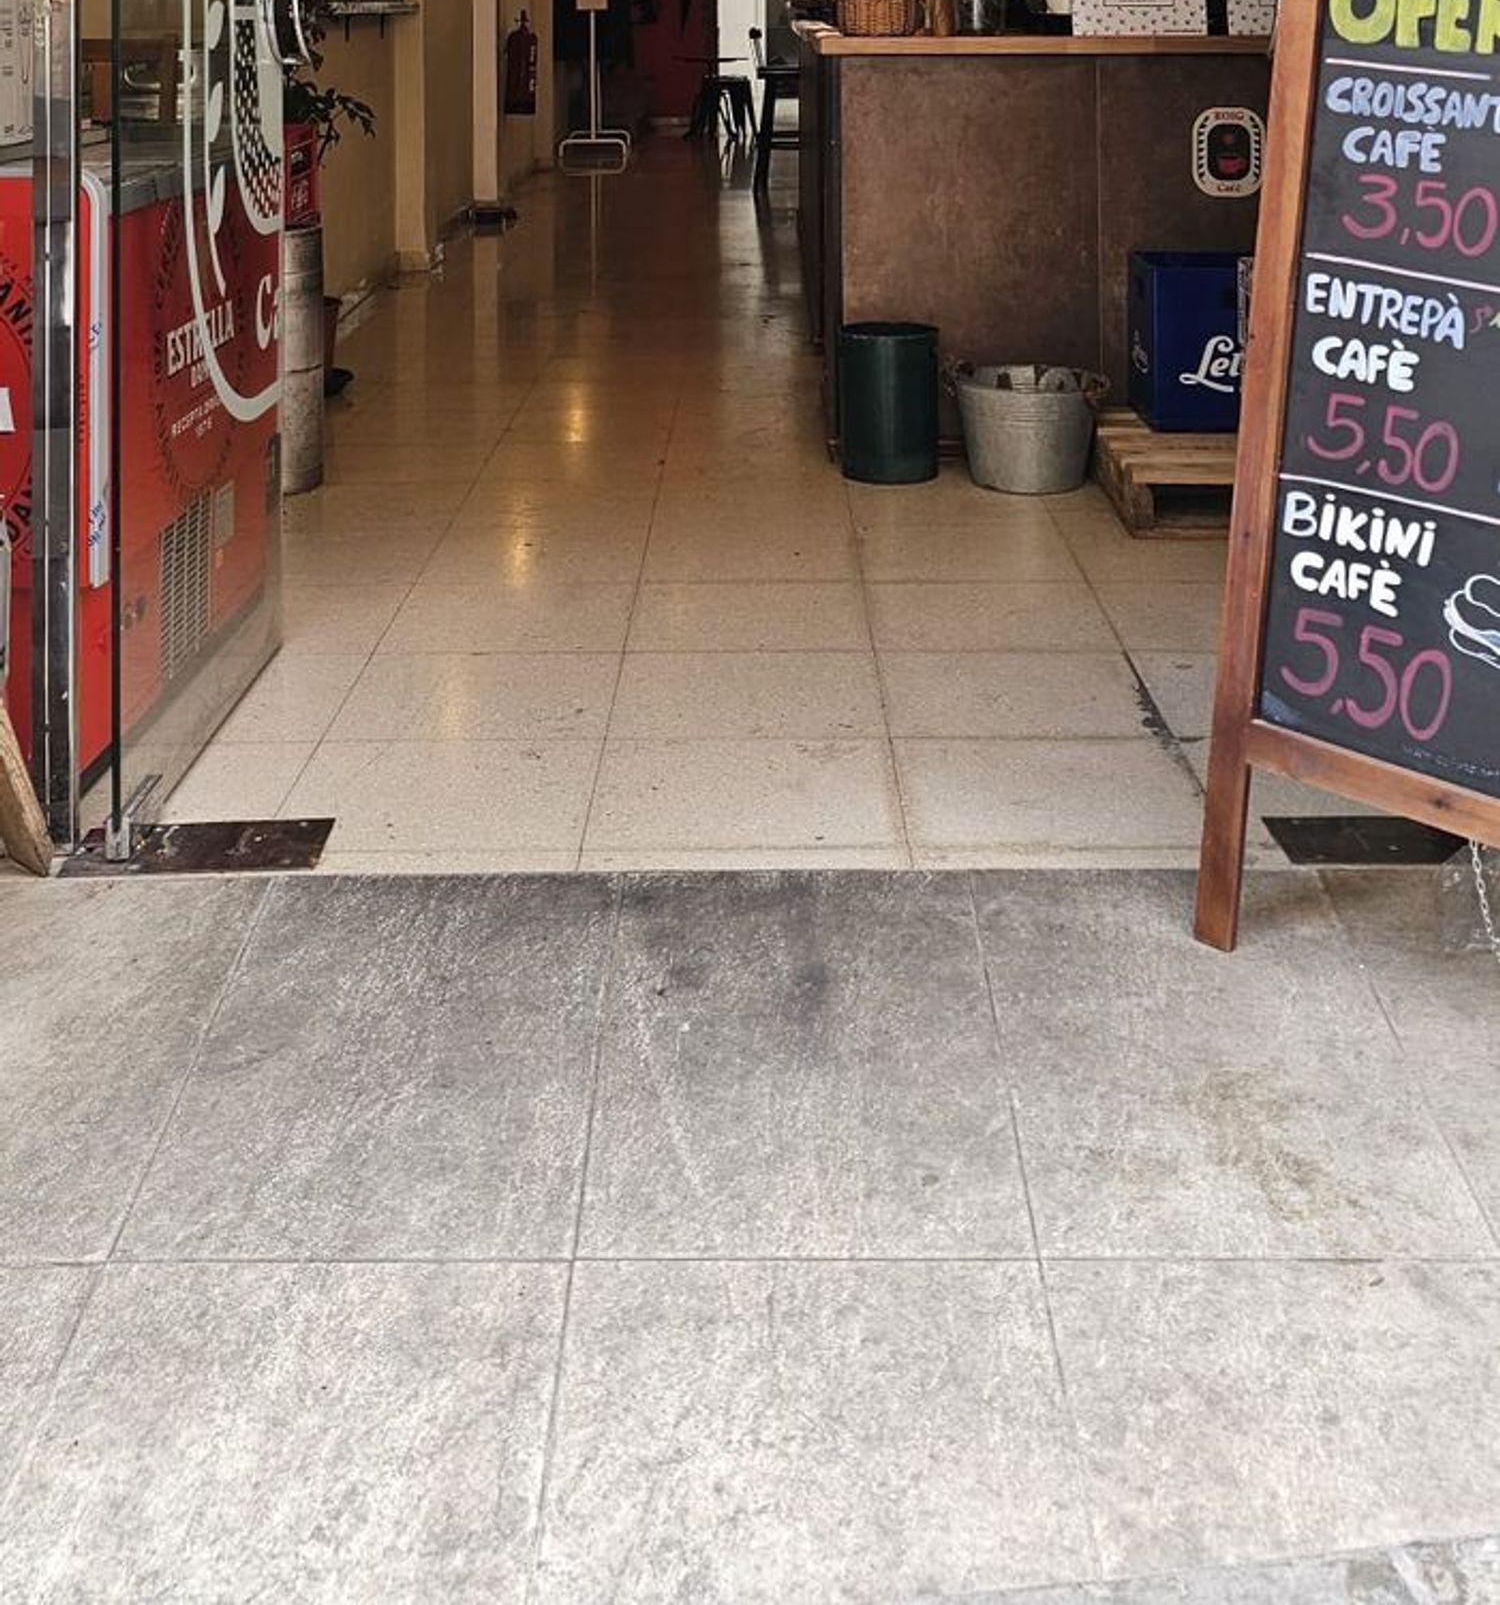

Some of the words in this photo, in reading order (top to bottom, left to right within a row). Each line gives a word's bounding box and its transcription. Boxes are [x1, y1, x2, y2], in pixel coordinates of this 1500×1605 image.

[1342, 125, 1447, 173] CAFÈ
[1341, 173, 1498, 257] 3,50
[1305, 273, 1466, 350] ENTREPÀ
[1312, 336, 1421, 393] CAFÈ
[1307, 392, 1460, 492] 5,50
[1290, 550, 1402, 618] CAFÈ
[1280, 608, 1452, 741] 5,50
